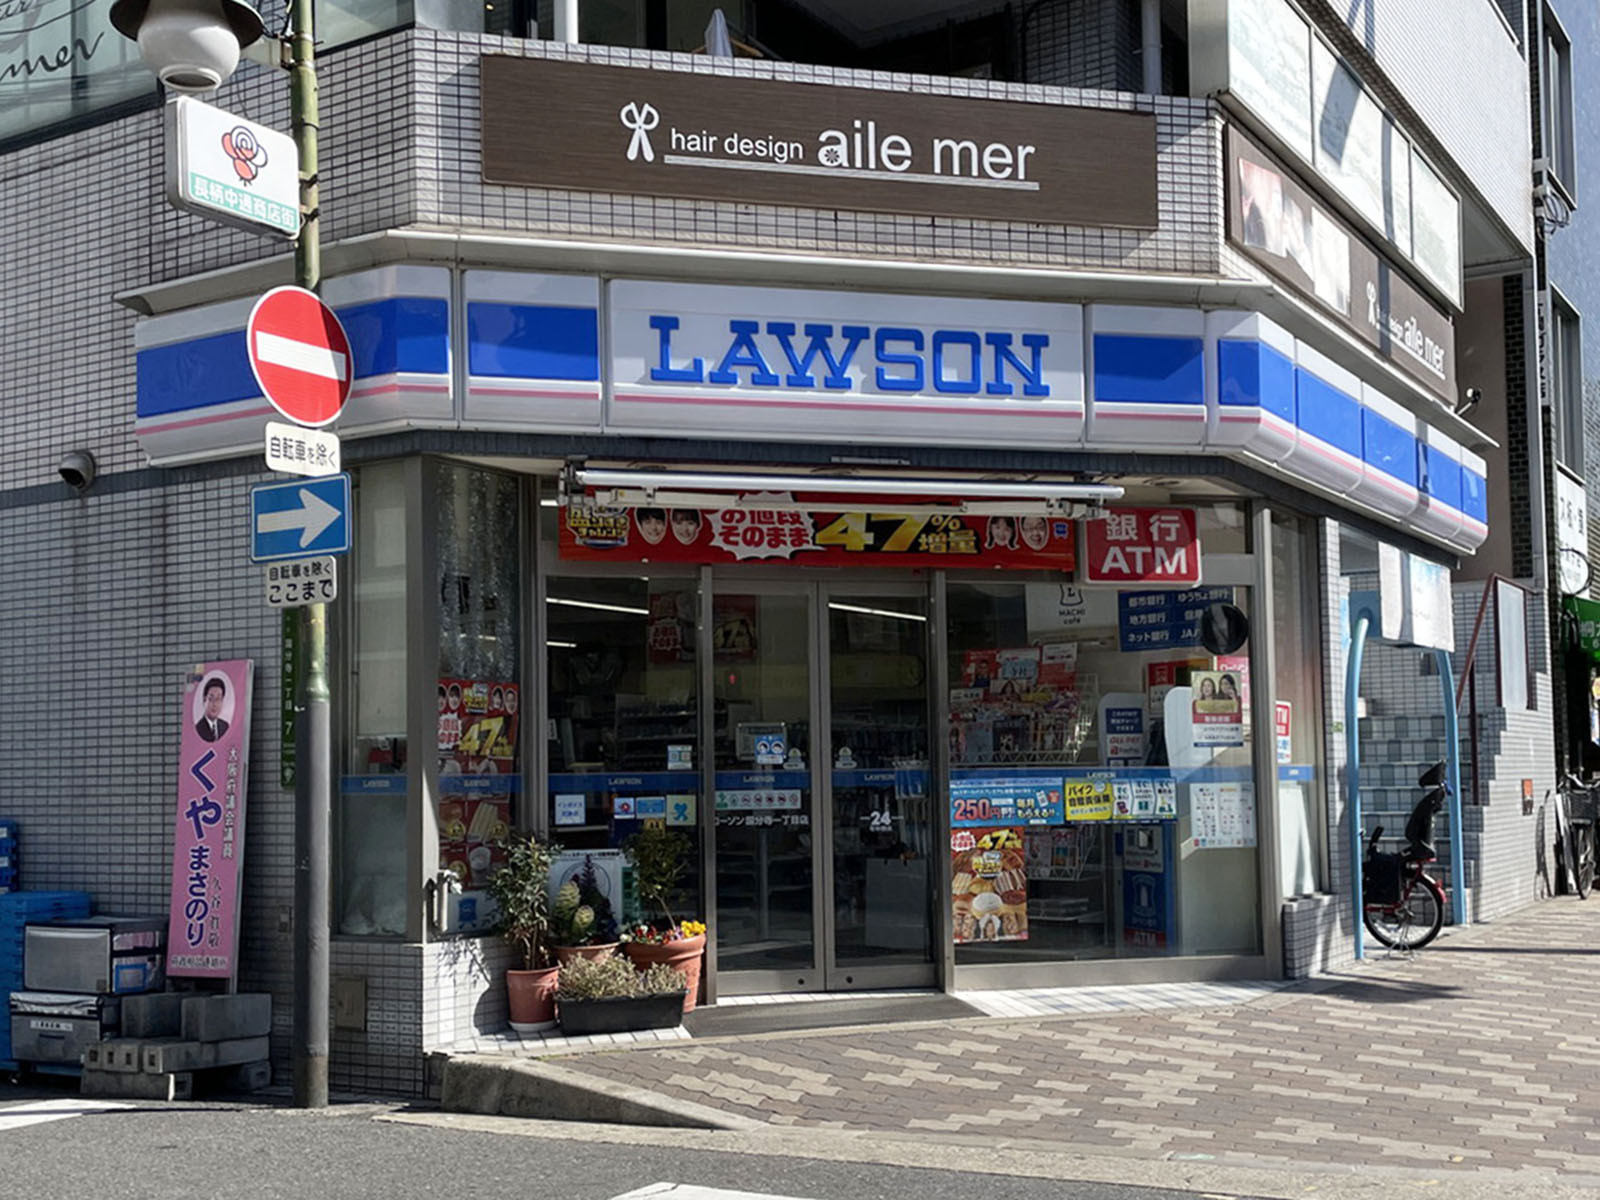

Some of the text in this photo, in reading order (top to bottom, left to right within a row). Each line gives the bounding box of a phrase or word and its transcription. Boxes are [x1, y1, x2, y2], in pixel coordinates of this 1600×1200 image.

[671, 119, 1035, 181] hair design aile mer
[649, 315, 1050, 397] LAWSON
[718, 526, 810, 549] そのまま
[1106, 514, 1180, 542] 銀行
[1101, 546, 1187, 574] ATM
[269, 580, 333, 604] ここまで
[1068, 785, 1093, 796] バイク
[870, 811, 892, 825] 24
[977, 829, 1010, 849] 47
